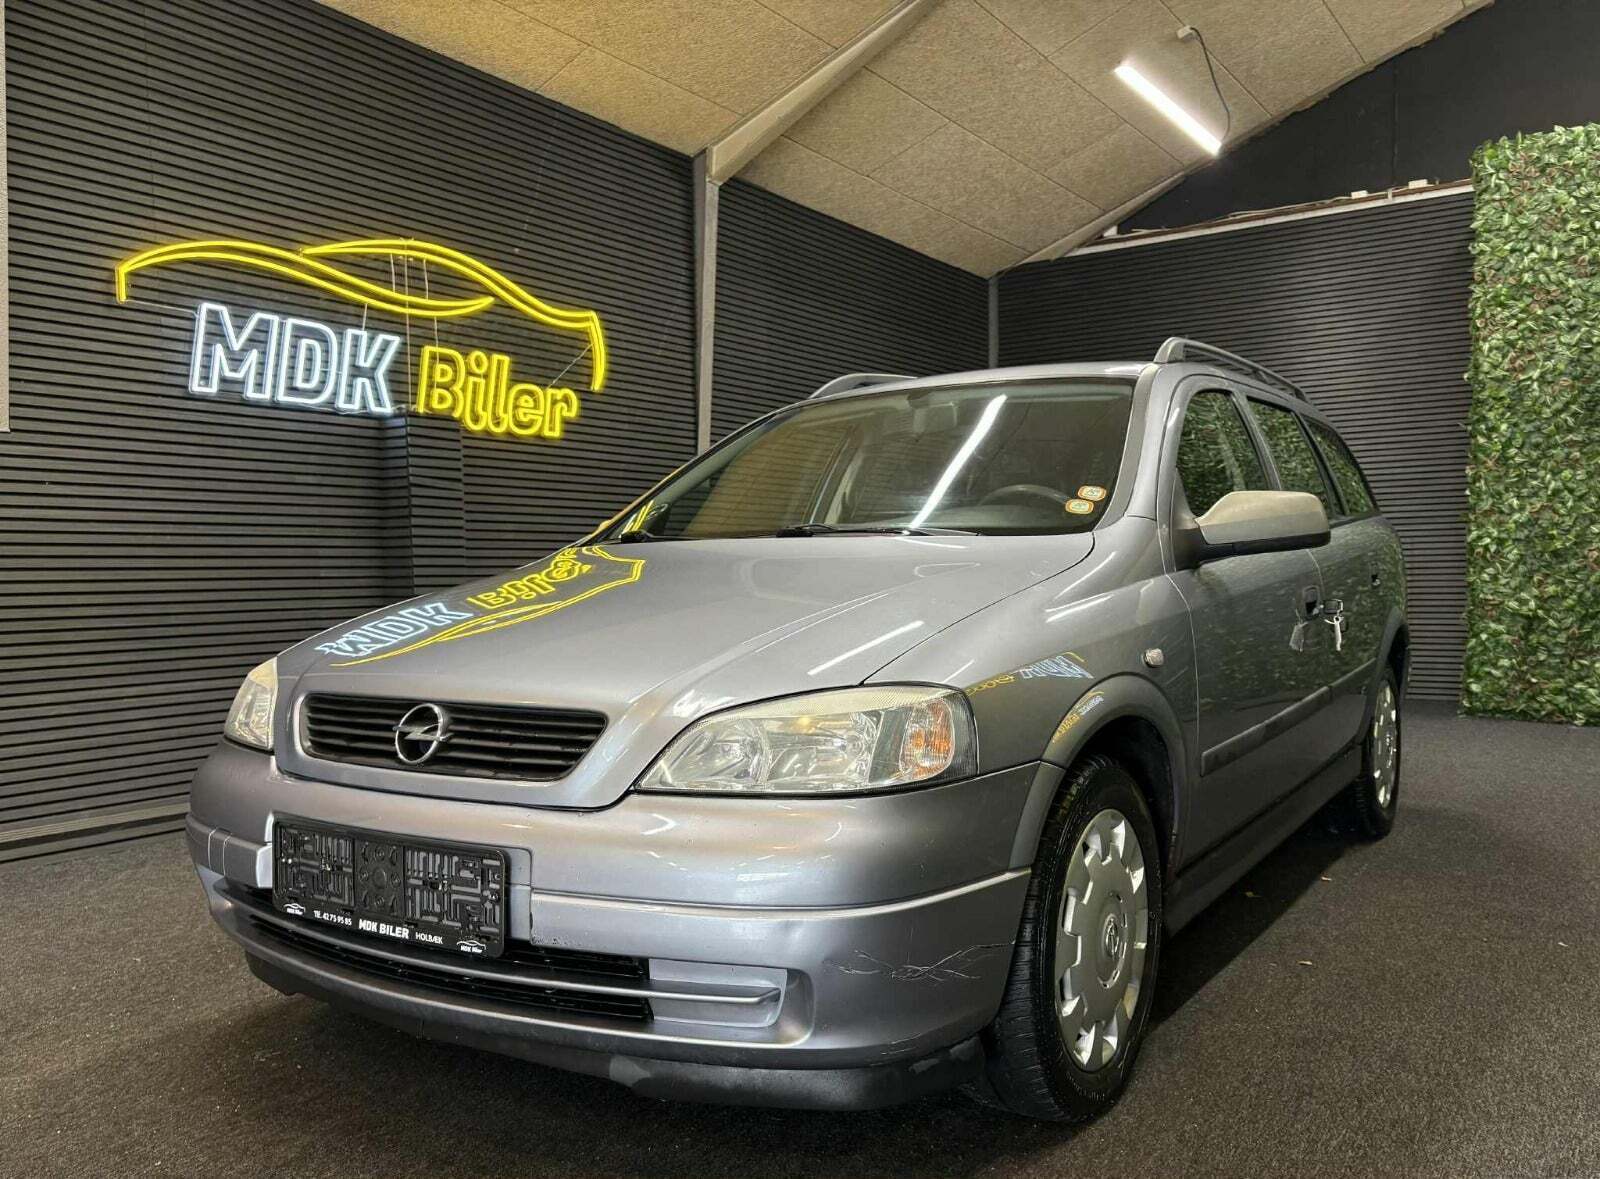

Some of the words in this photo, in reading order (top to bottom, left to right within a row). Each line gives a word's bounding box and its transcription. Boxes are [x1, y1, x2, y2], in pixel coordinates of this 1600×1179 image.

[189, 302, 401, 415] MDK
[417, 345, 579, 438] Biler
[359, 919, 378, 933] MDK
[379, 923, 409, 939] BILER
[415, 932, 443, 945] HOLBÆK
